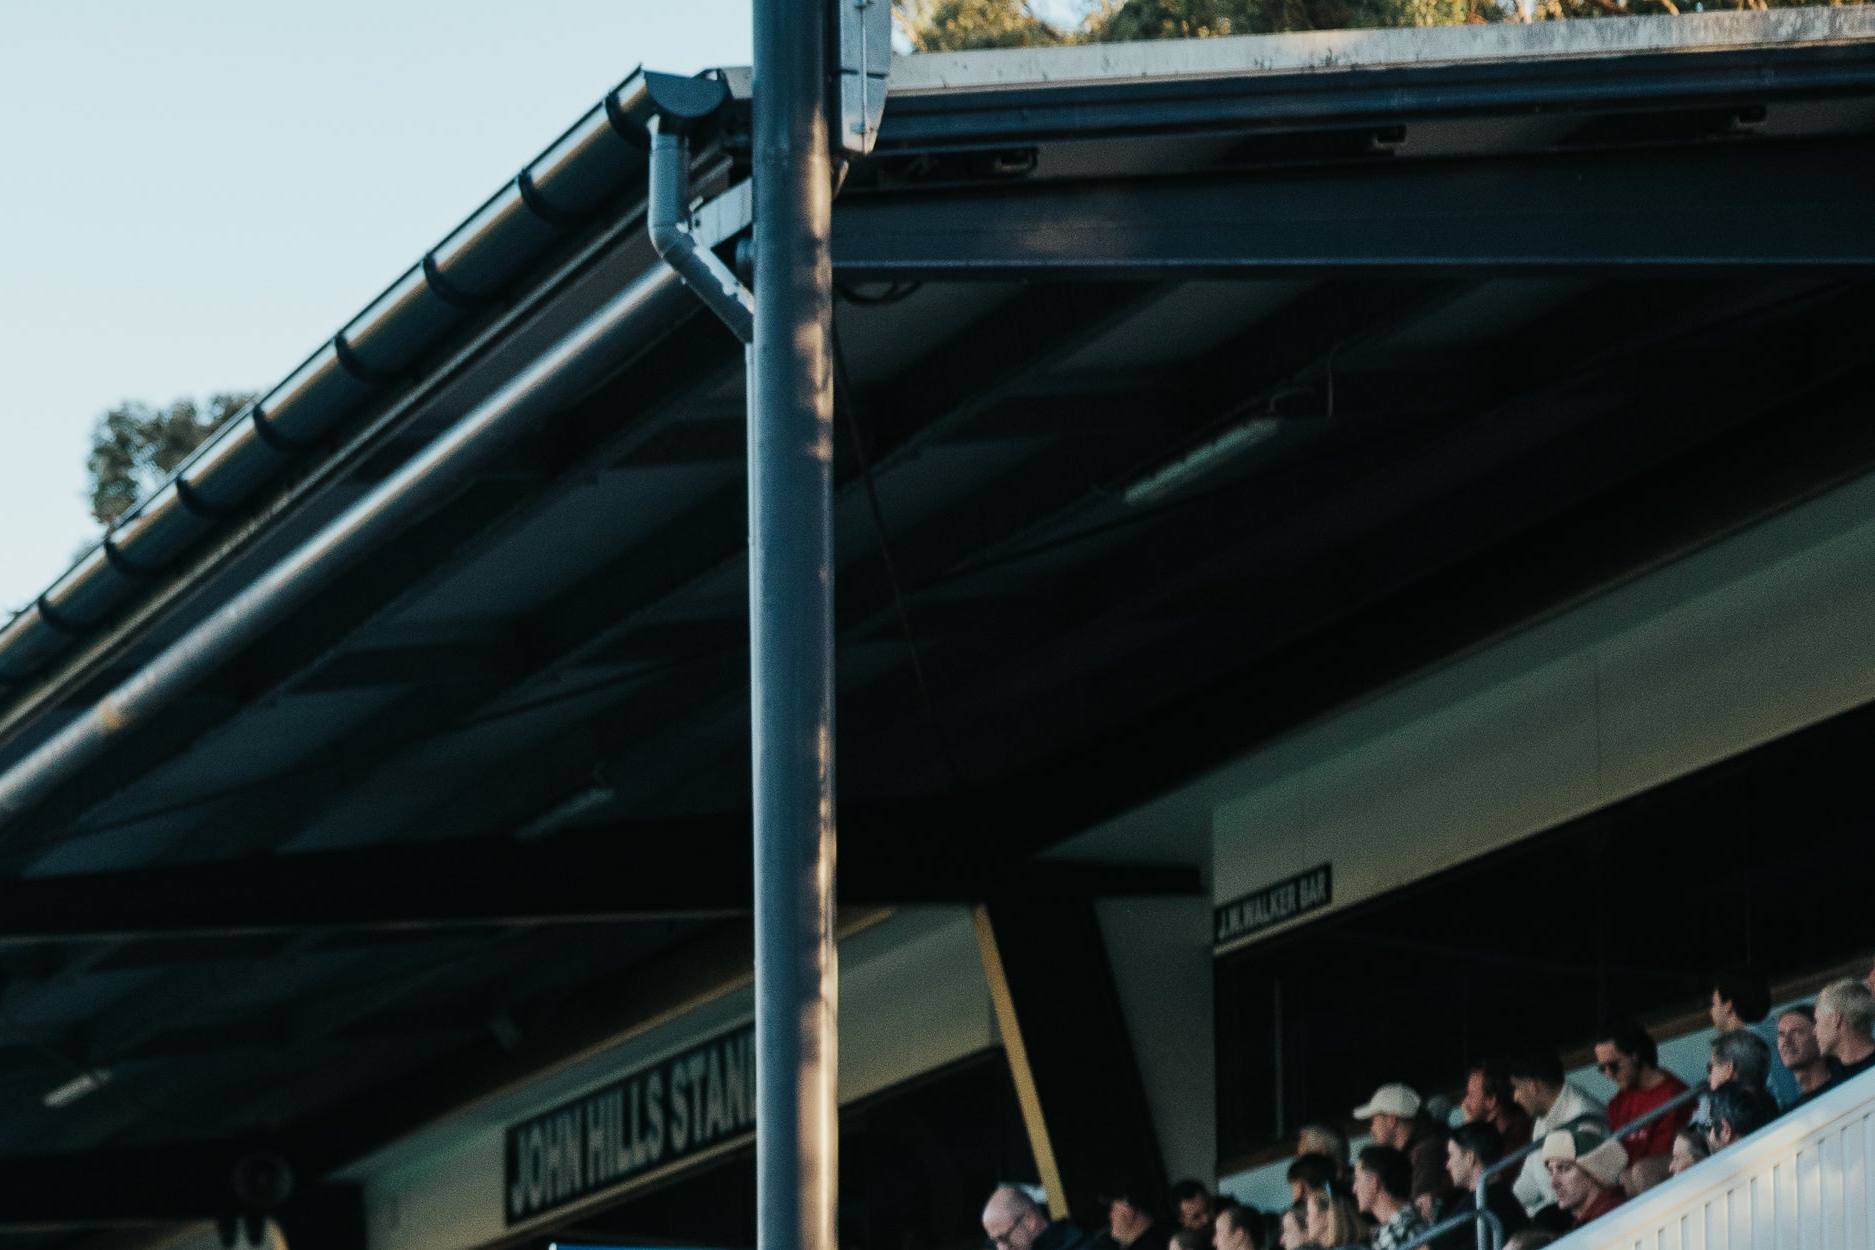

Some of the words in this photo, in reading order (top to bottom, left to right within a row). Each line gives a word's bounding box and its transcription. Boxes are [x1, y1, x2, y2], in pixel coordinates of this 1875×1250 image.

[1299, 870, 1327, 910] BAR
[511, 1106, 582, 1216] JOHN
[586, 1070, 664, 1188] HILLS
